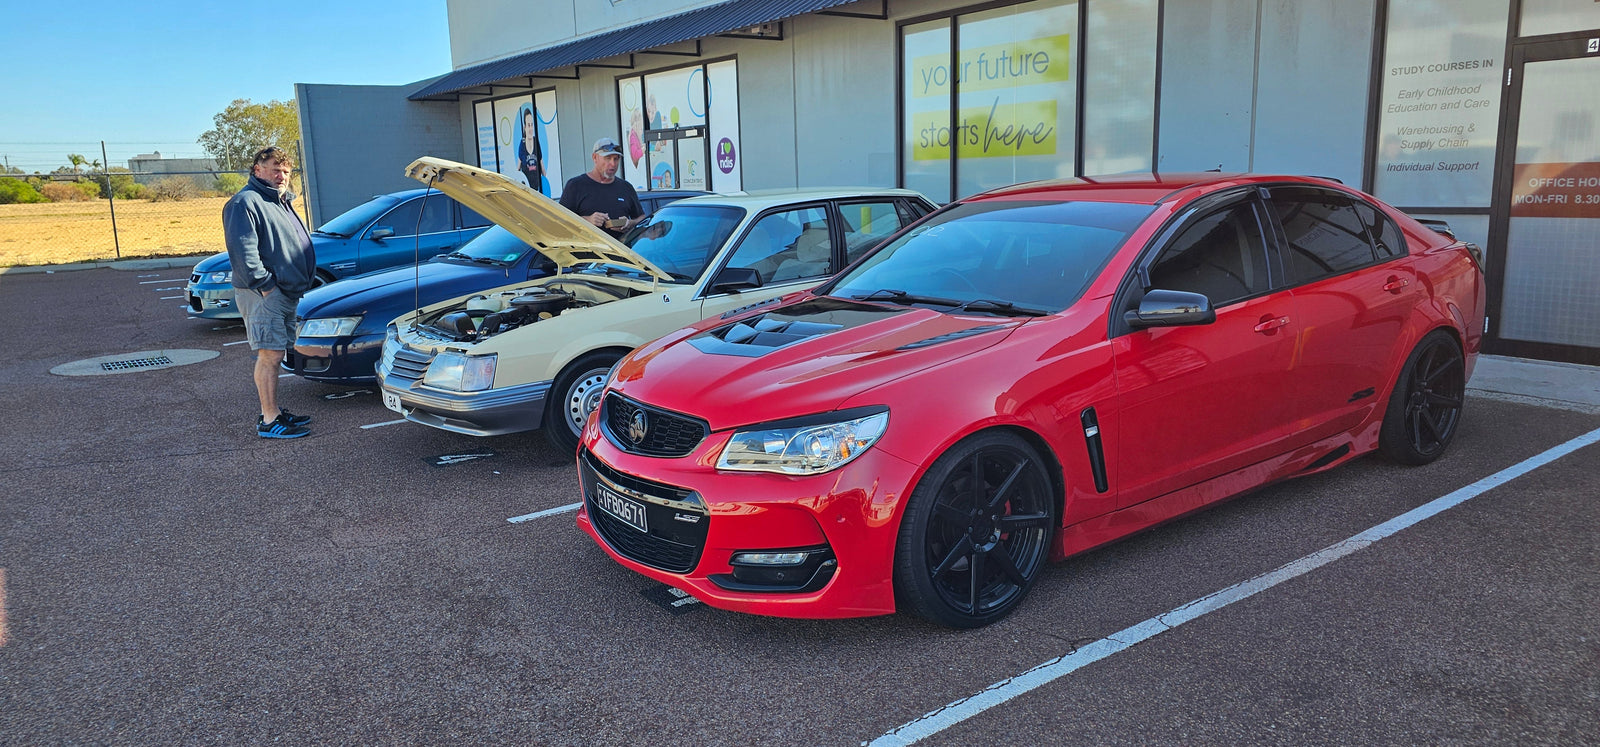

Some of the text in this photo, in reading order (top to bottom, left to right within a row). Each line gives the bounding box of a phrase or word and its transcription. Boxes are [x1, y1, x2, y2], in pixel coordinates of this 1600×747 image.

[1589, 40, 1598, 51] 4
[976, 50, 1050, 81] future
[1391, 58, 1494, 76] STUDY COURSES IN
[1397, 83, 1482, 100] Early Childhood
[1387, 98, 1490, 113] Education and Care
[983, 95, 1054, 153] here
[1397, 122, 1476, 136] Warehousing &
[1400, 137, 1469, 151] Supply Chain
[1386, 161, 1480, 172] Individual Support
[1528, 177, 1600, 188] OFFICE HO
[1514, 194, 1568, 204] MON-FRI
